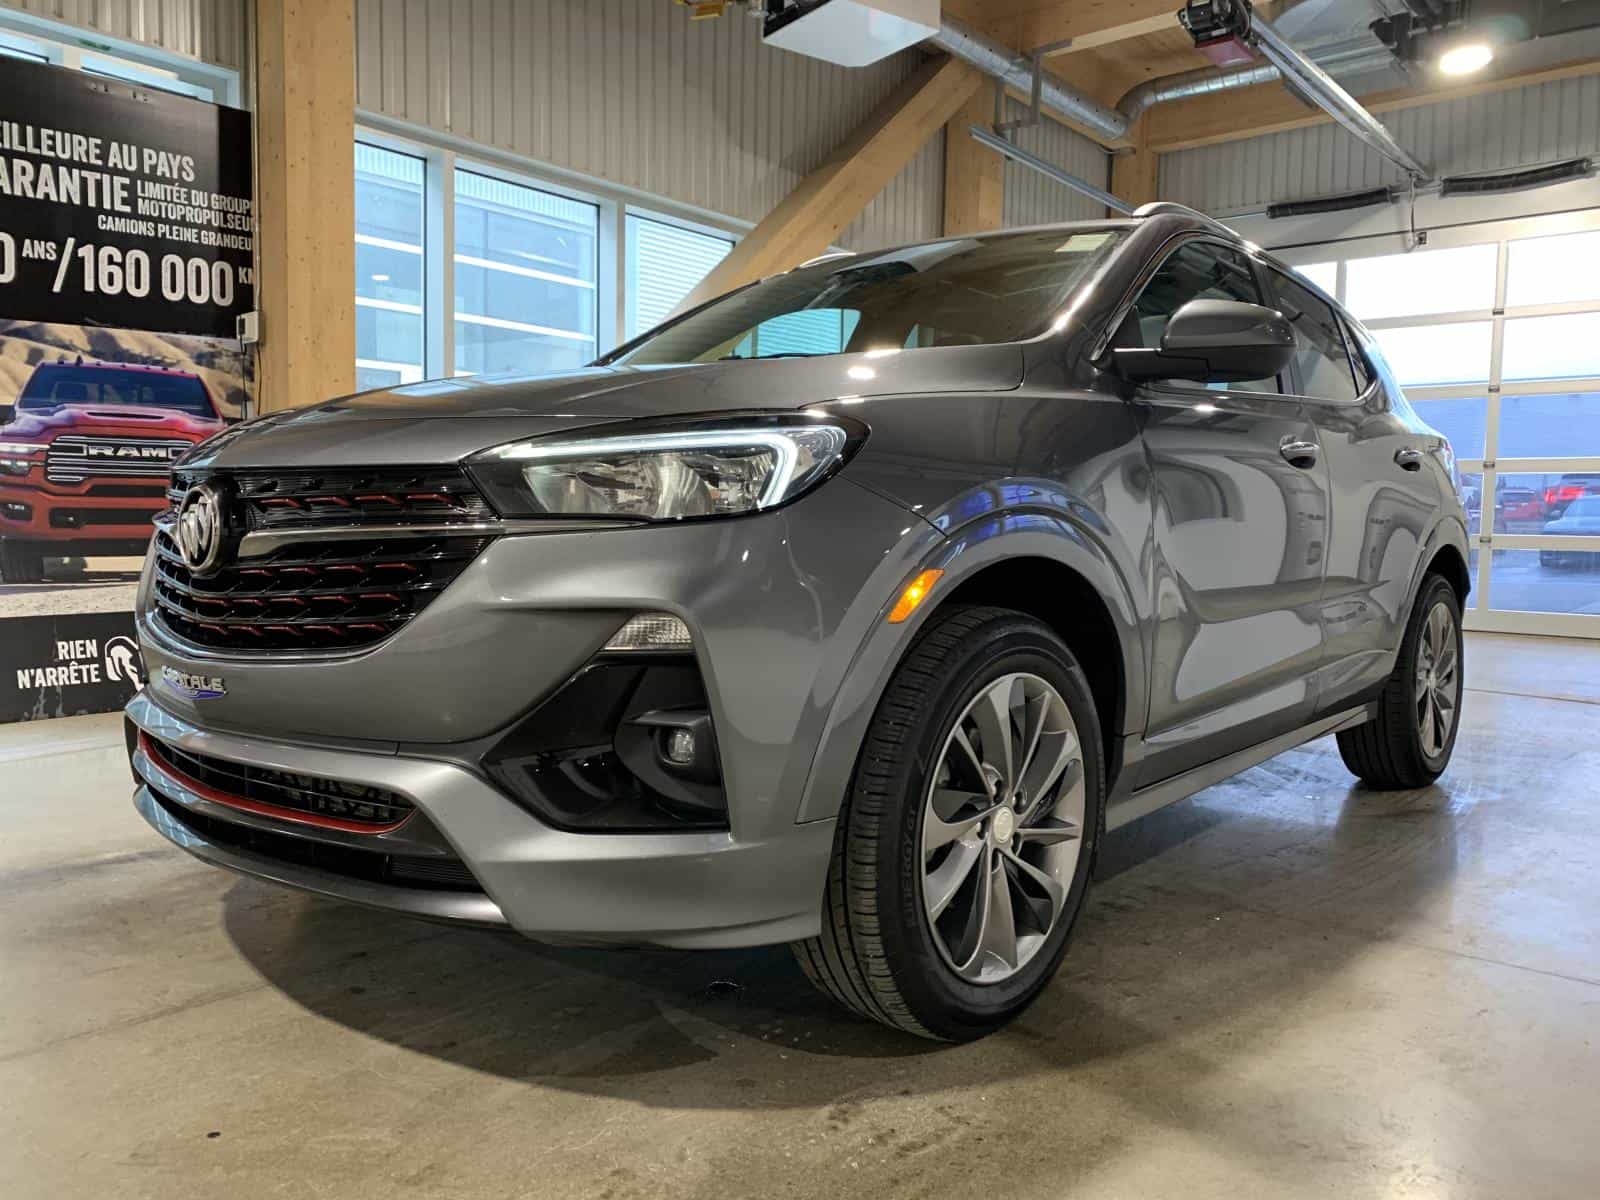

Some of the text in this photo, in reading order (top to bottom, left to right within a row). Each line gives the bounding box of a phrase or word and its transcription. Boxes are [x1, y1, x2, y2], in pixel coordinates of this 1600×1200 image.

[108, 142, 137, 171] AU
[143, 148, 195, 182] PAYS
[137, 179, 252, 215] LIMITÉE DU GROUP
[137, 198, 252, 232] MOTOPROPULSEU
[98, 215, 252, 251] CAMIONS PLEINE GRANDEU
[22, 239, 57, 261] ANS
[161, 254, 234, 306] 000
[88, 446, 168, 458] RAM
[57, 639, 98, 660] RIEN
[16, 661, 101, 689] N'ARRÊTE
